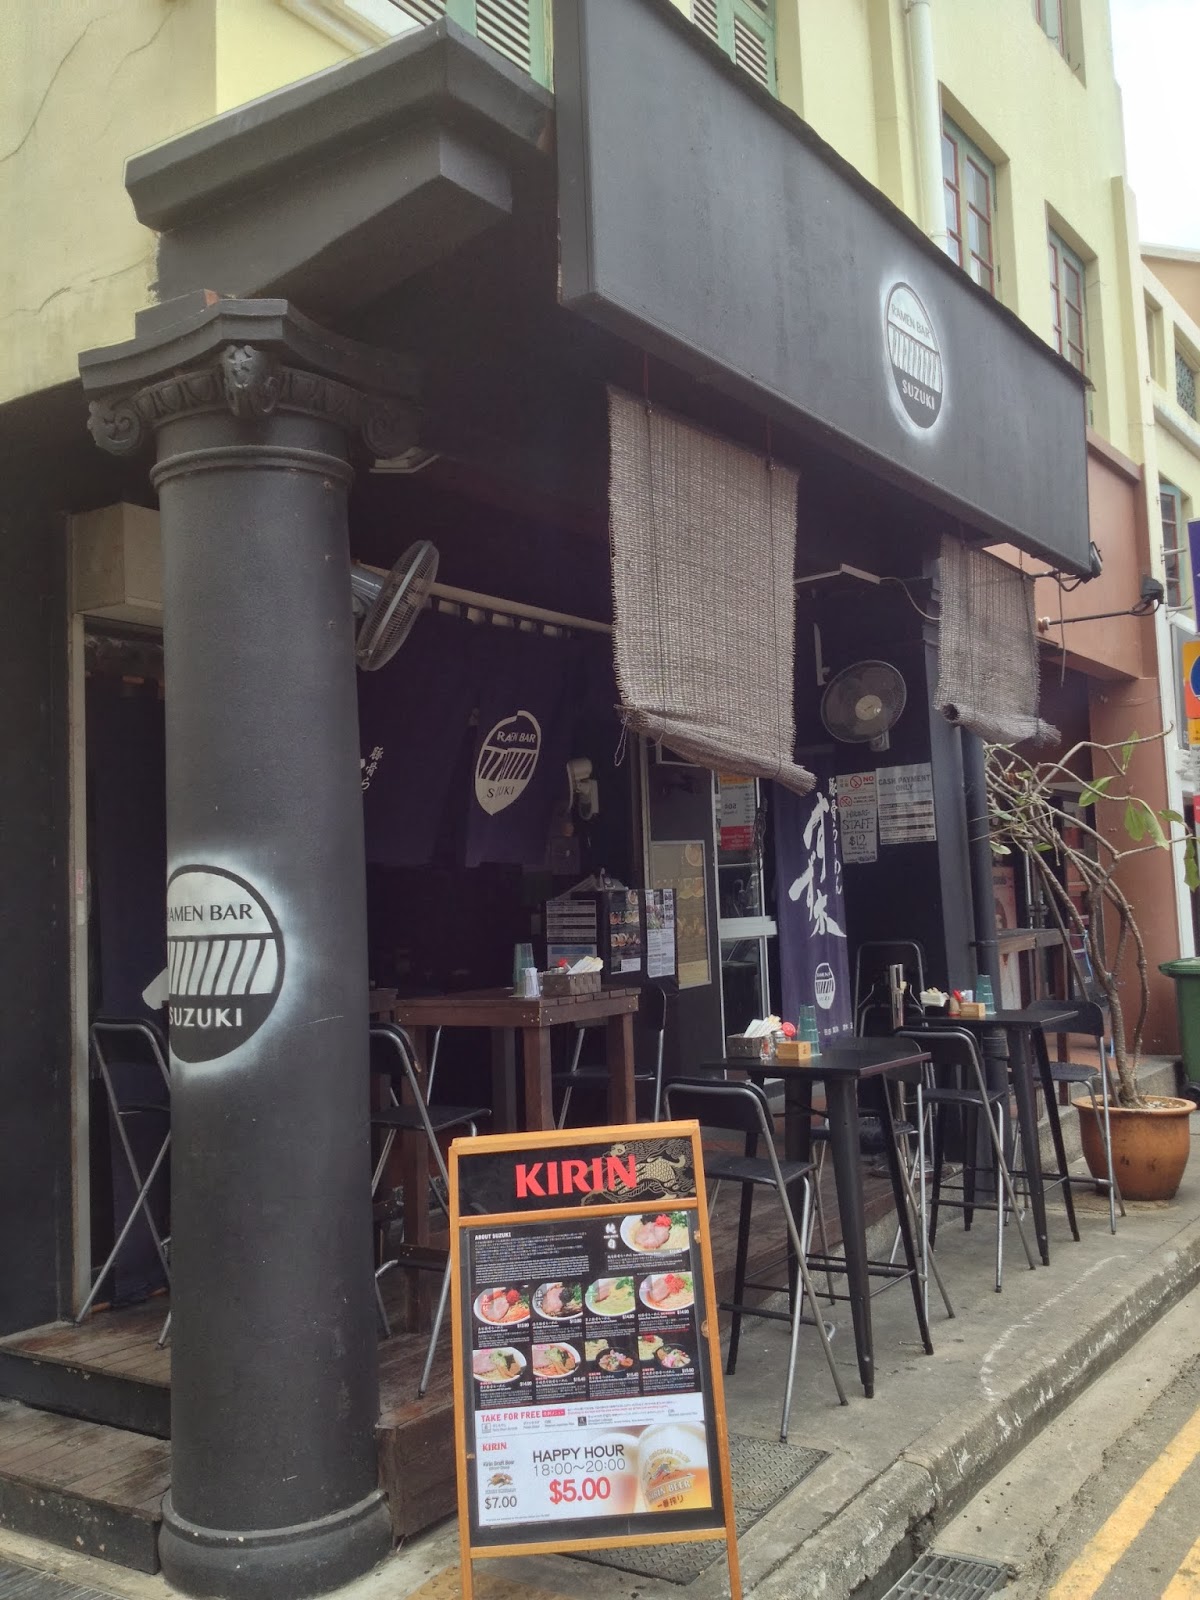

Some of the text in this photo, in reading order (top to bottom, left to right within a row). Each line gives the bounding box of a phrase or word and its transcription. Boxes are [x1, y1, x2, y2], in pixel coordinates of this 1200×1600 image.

[891, 303, 931, 339] RAMEN BAR
[902, 379, 935, 411] SUZUKI
[519, 732, 536, 743] BAR
[878, 774, 931, 786] CASH PAYMENT
[895, 783, 913, 792] ONLY
[842, 817, 874, 831] STAFF
[209, 903, 253, 921] BAR
[169, 1007, 242, 1028] SUZUKI
[515, 1154, 638, 1199] KIRIN
[474, 1231, 512, 1241] ABOUT SUZUKI
[481, 1413, 502, 1423] TAKE
[503, 1411, 519, 1421] FOR
[520, 1410, 541, 1419] FREE
[482, 1441, 508, 1452] KIRIN
[532, 1444, 625, 1463] HAPPY HOUR
[549, 1476, 611, 1505] $5.00
[668, 1479, 691, 1492] BEER
[484, 1495, 518, 1510] $7.00
